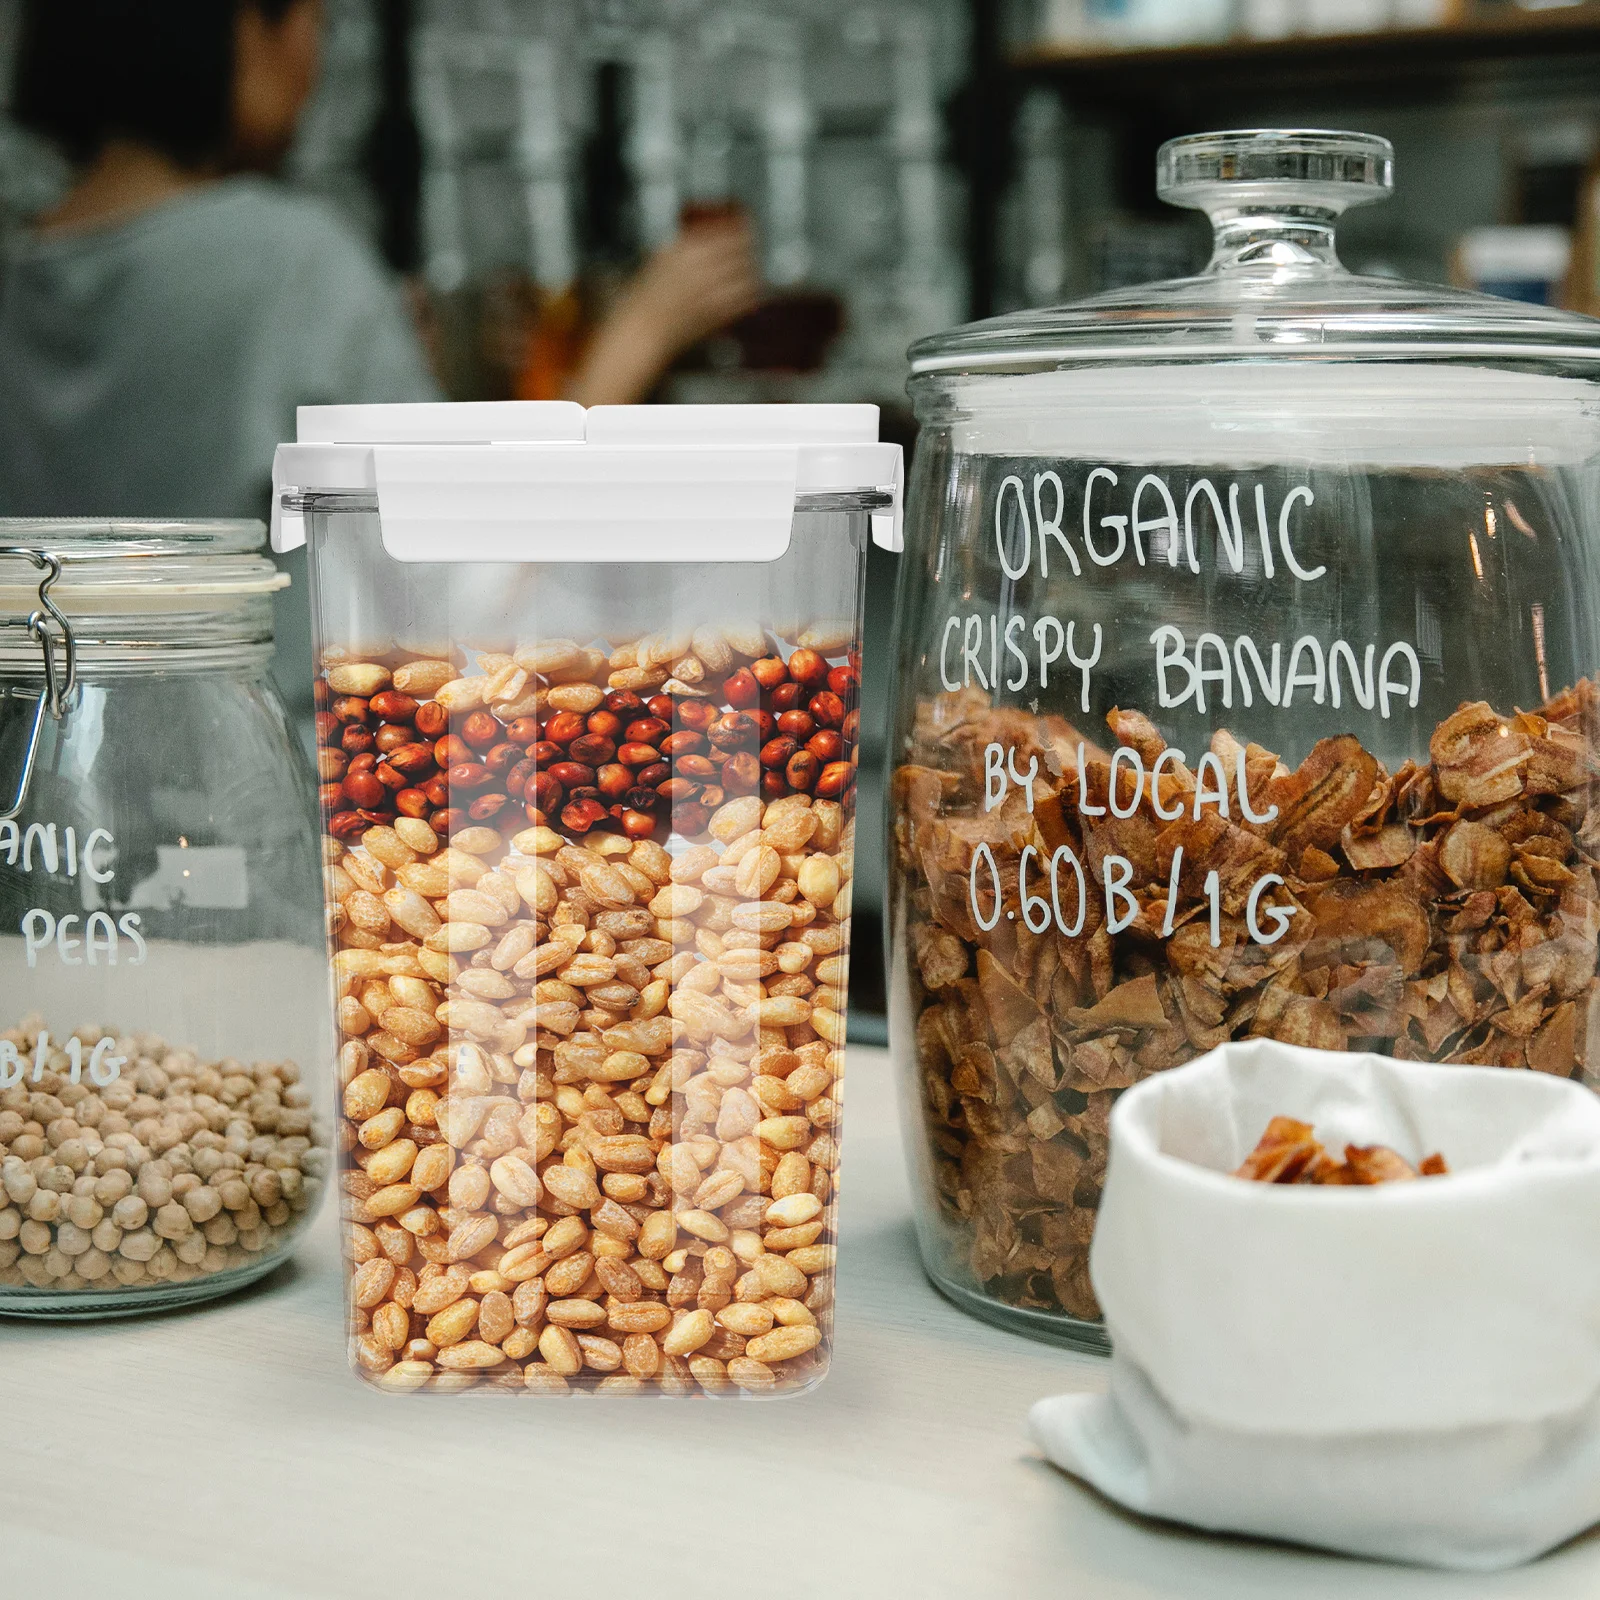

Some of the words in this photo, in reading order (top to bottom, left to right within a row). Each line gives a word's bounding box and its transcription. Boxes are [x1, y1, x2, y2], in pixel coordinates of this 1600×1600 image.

[995, 467, 1327, 582] ORGANIC
[940, 614, 1103, 713] CRISPY
[1149, 625, 1421, 719] BANANA
[984, 742, 1038, 814] BY
[1078, 741, 1279, 825] LOCAL
[21, 908, 147, 968] PEAS
